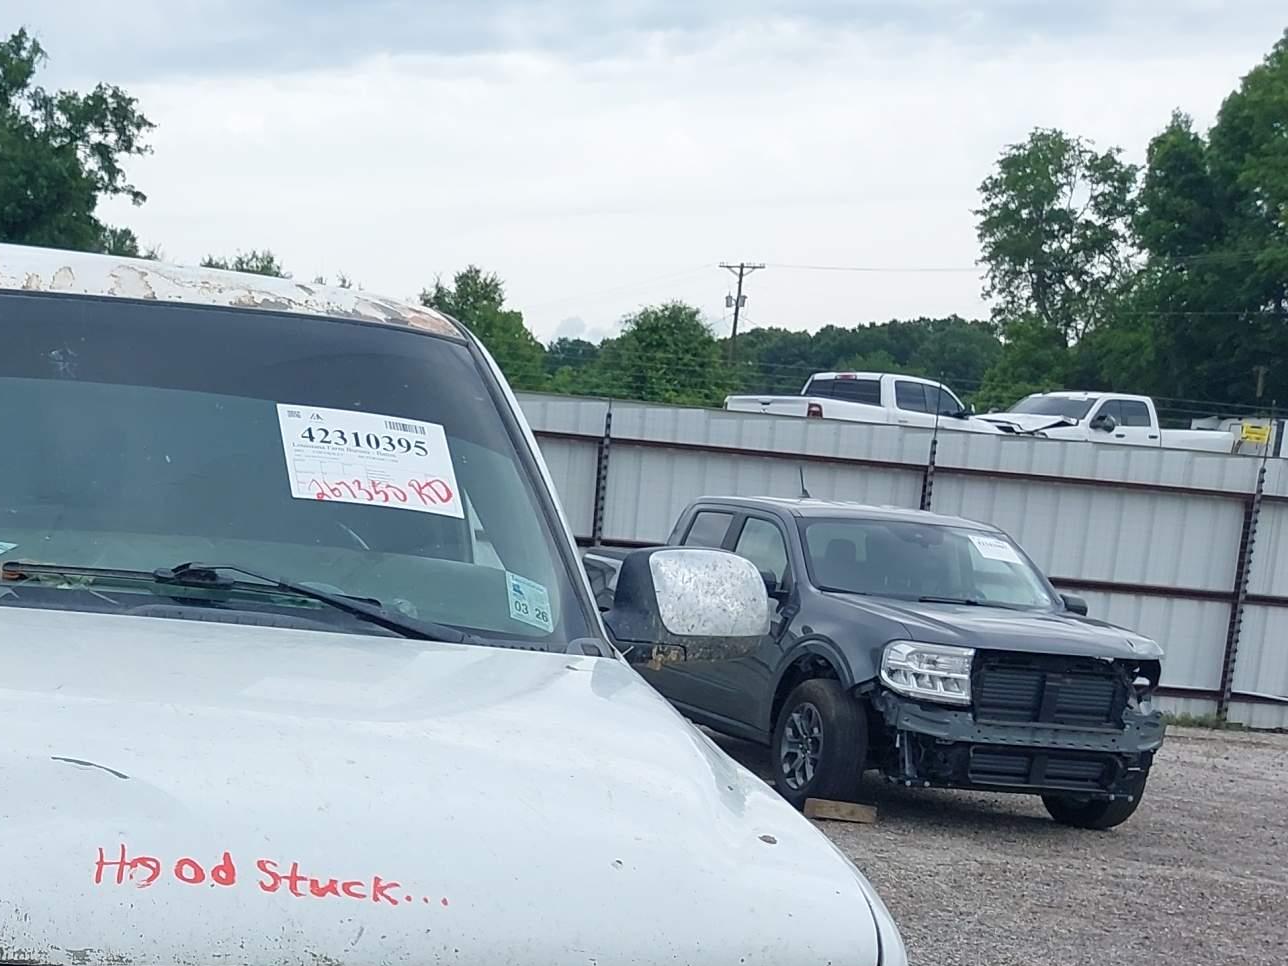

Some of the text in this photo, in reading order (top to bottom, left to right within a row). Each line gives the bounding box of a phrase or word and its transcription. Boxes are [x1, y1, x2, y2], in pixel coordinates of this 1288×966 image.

[300, 426, 429, 457] 42310395
[514, 601, 548, 622] 03 26
